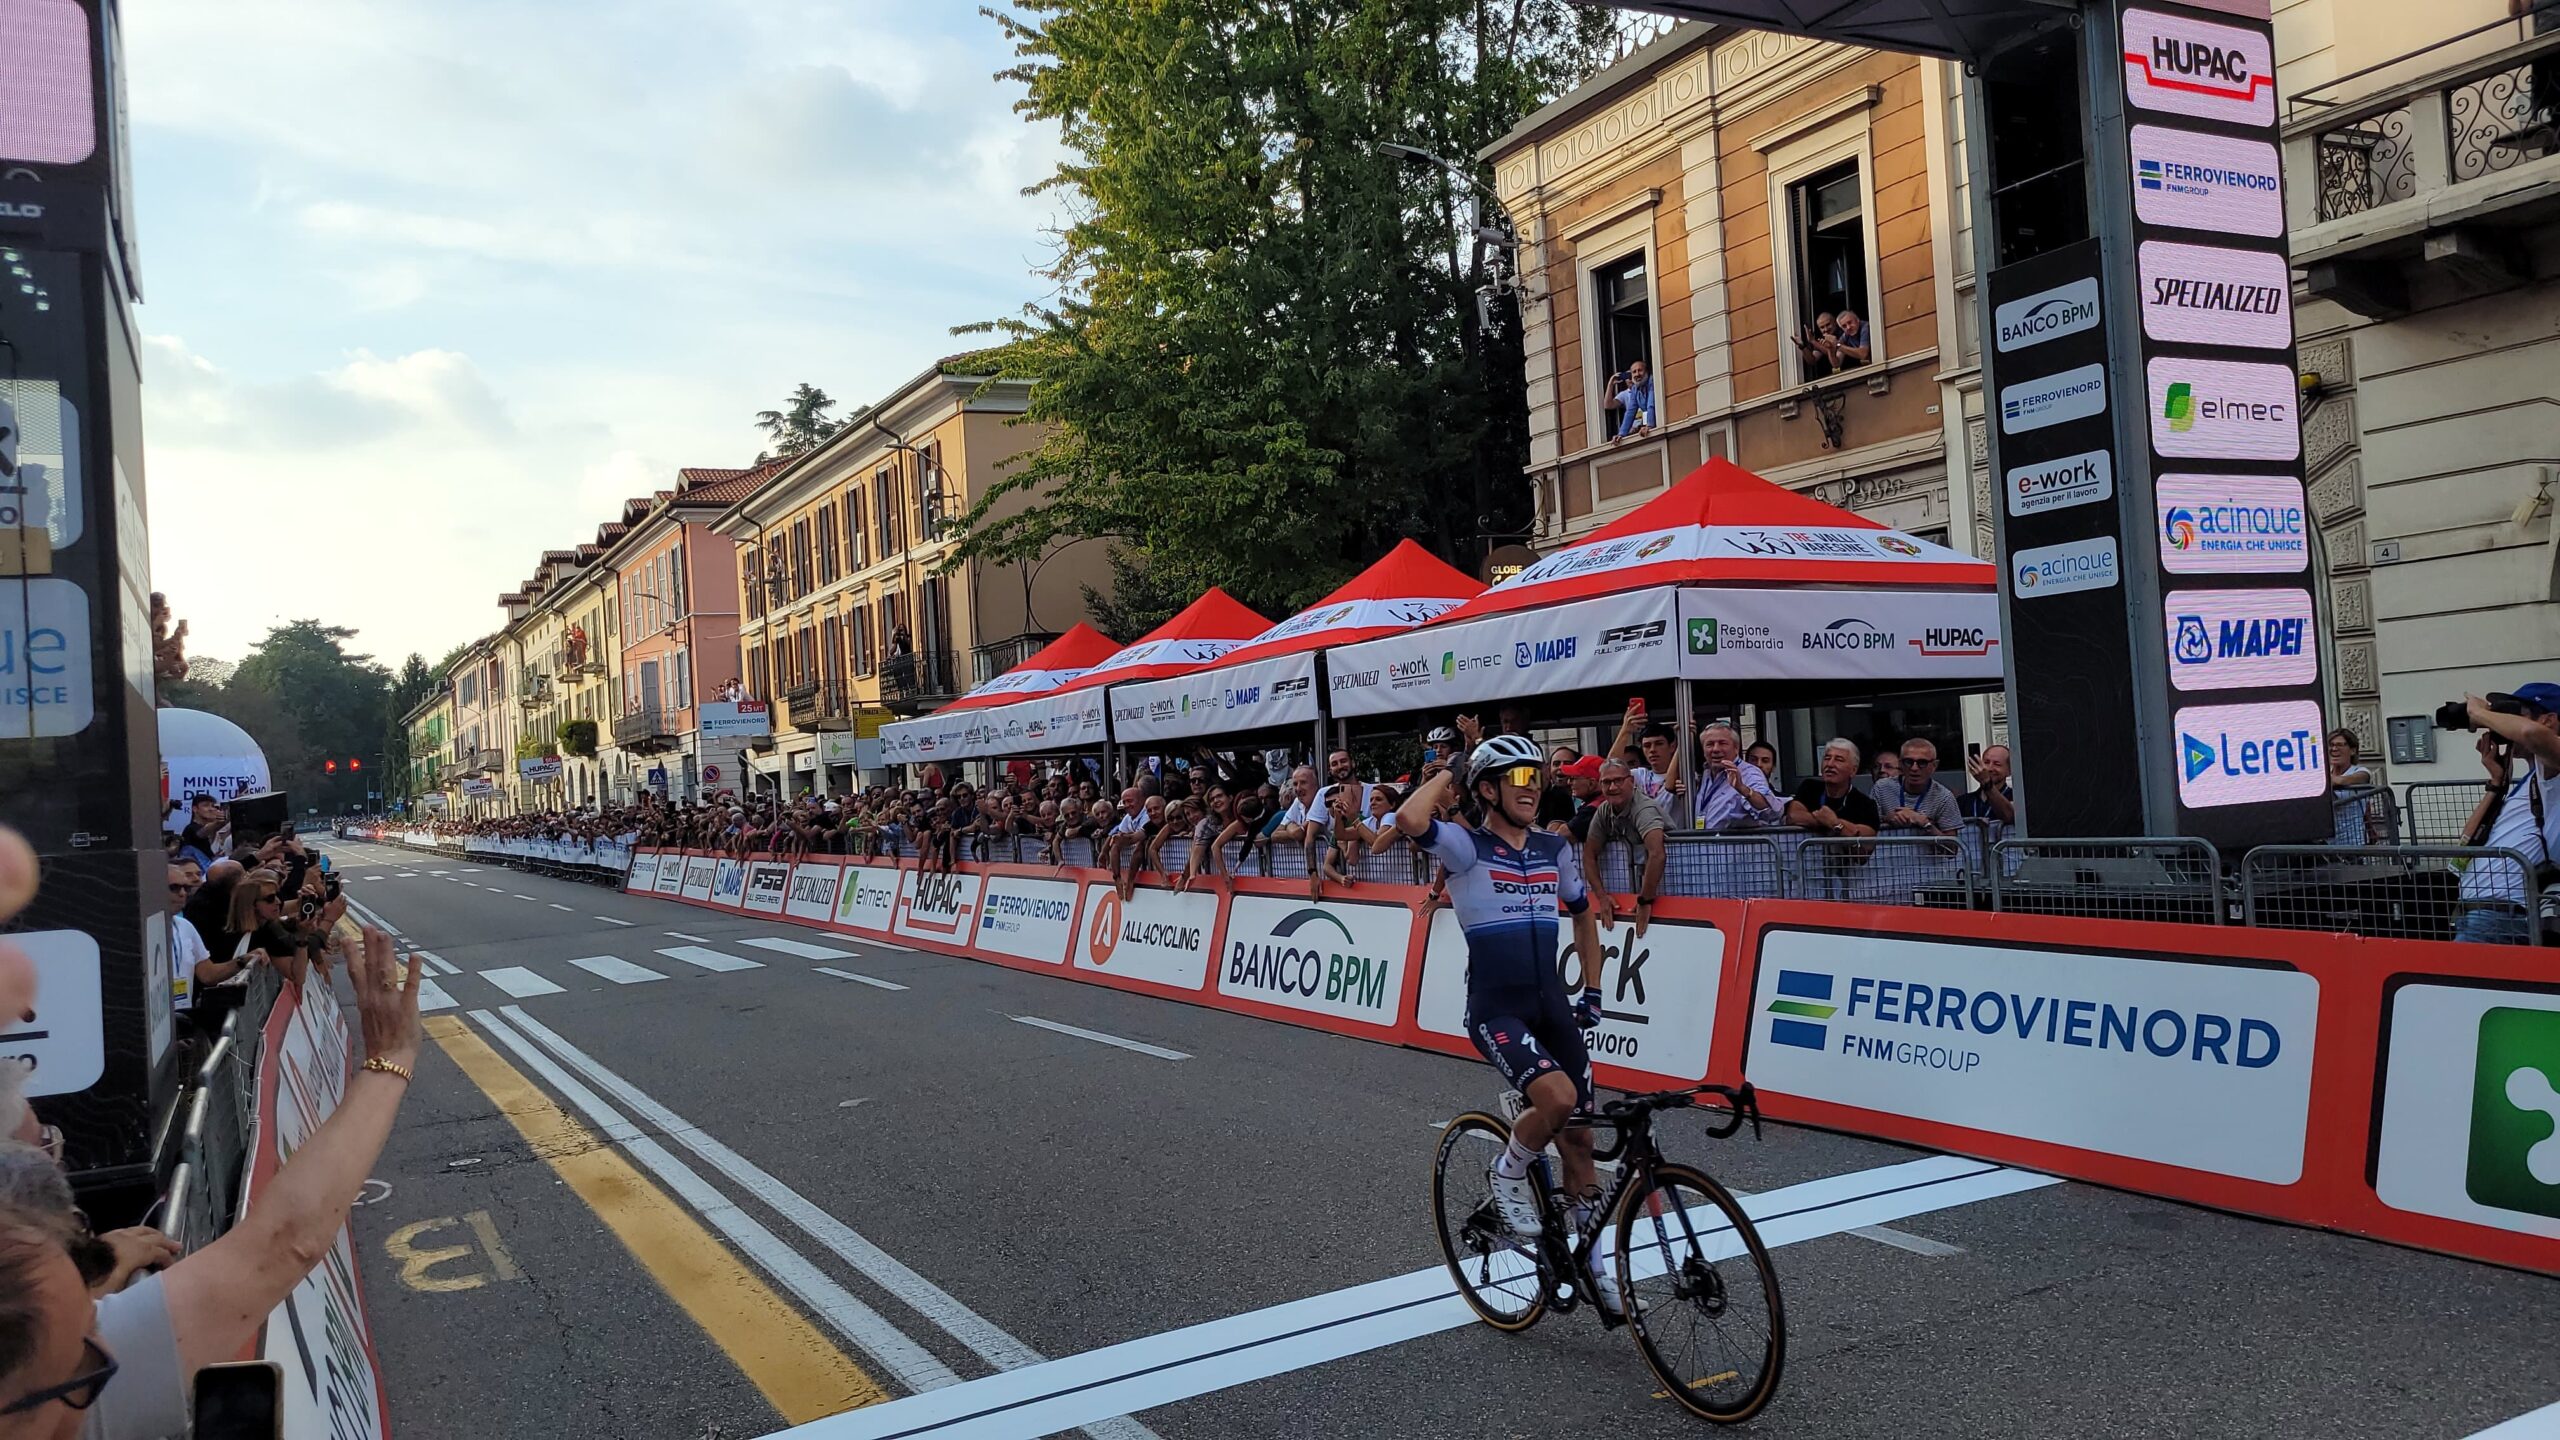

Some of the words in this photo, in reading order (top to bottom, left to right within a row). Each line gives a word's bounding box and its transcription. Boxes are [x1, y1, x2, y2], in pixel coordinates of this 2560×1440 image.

[2152, 36, 2247, 83] HUPAC
[2165, 162, 2277, 191] FERROVIENORD
[2150, 277, 2281, 315] SPECIALIZED
[2002, 313, 2059, 342] BANCO
[2062, 302, 2094, 325] BPM
[2022, 380, 2101, 408] FERROVIENORD
[2201, 397, 2285, 421] elmec
[2018, 459, 2097, 494] e-work
[2021, 496, 2050, 509] agenzia
[2052, 493, 2065, 505] per
[2066, 491, 2072, 500] il
[2073, 487, 2098, 498] lavoro
[2199, 498, 2301, 534] acinque
[1782, 532, 1816, 542] TRE
[1813, 533, 1854, 543] VALLI
[2201, 540, 2242, 550] ENERGIA
[2246, 540, 2265, 550] CHE
[2268, 540, 2302, 550] UNISCE
[2041, 551, 2112, 577] acinque
[2380, 547, 2390, 558] 4
[1491, 564, 1523, 575] GLOBE
[2042, 576, 2071, 586] ENERGIA
[2072, 573, 2087, 582] CHE
[2088, 570, 2113, 580] UNISCE
[1720, 624, 1770, 637] Regione
[1802, 632, 1860, 649] BANCO
[1864, 632, 1895, 649] BPM
[1925, 628, 1984, 646] HUPAC
[2218, 618, 2303, 658] MAPEI
[1534, 636, 1577, 663] MAPEI
[1720, 637, 1784, 650] Lombardia
[1389, 655, 1429, 678] e-work
[1458, 653, 1502, 671] elmec
[1332, 670, 1379, 691] SPECIALIZED
[741, 703, 753, 713] 25
[1150, 697, 1175, 713] e-work
[1191, 696, 1218, 710] elmec
[1236, 686, 1260, 706] MAPEI
[714, 717, 766, 726] FERROVIENORD
[2220, 729, 2319, 777] LereTi
[529, 764, 553, 774] HUPAC
[722, 867, 745, 896] MAPEI
[789, 875, 836, 905] SPECIALIZED
[856, 884, 891, 909] elmec
[913, 877, 962, 916] HUPAC
[998, 895, 1070, 922] FERROVIENORD
[1121, 919, 1200, 954] ALL4CYCLING
[1229, 941, 1321, 994] BANCO
[1325, 954, 1387, 1010] BPM
[1846, 977, 2281, 1068] FERROVIENORD
[1584, 1030, 1639, 1057] avoro
[1842, 1034, 1981, 1073] FNMGROUP
